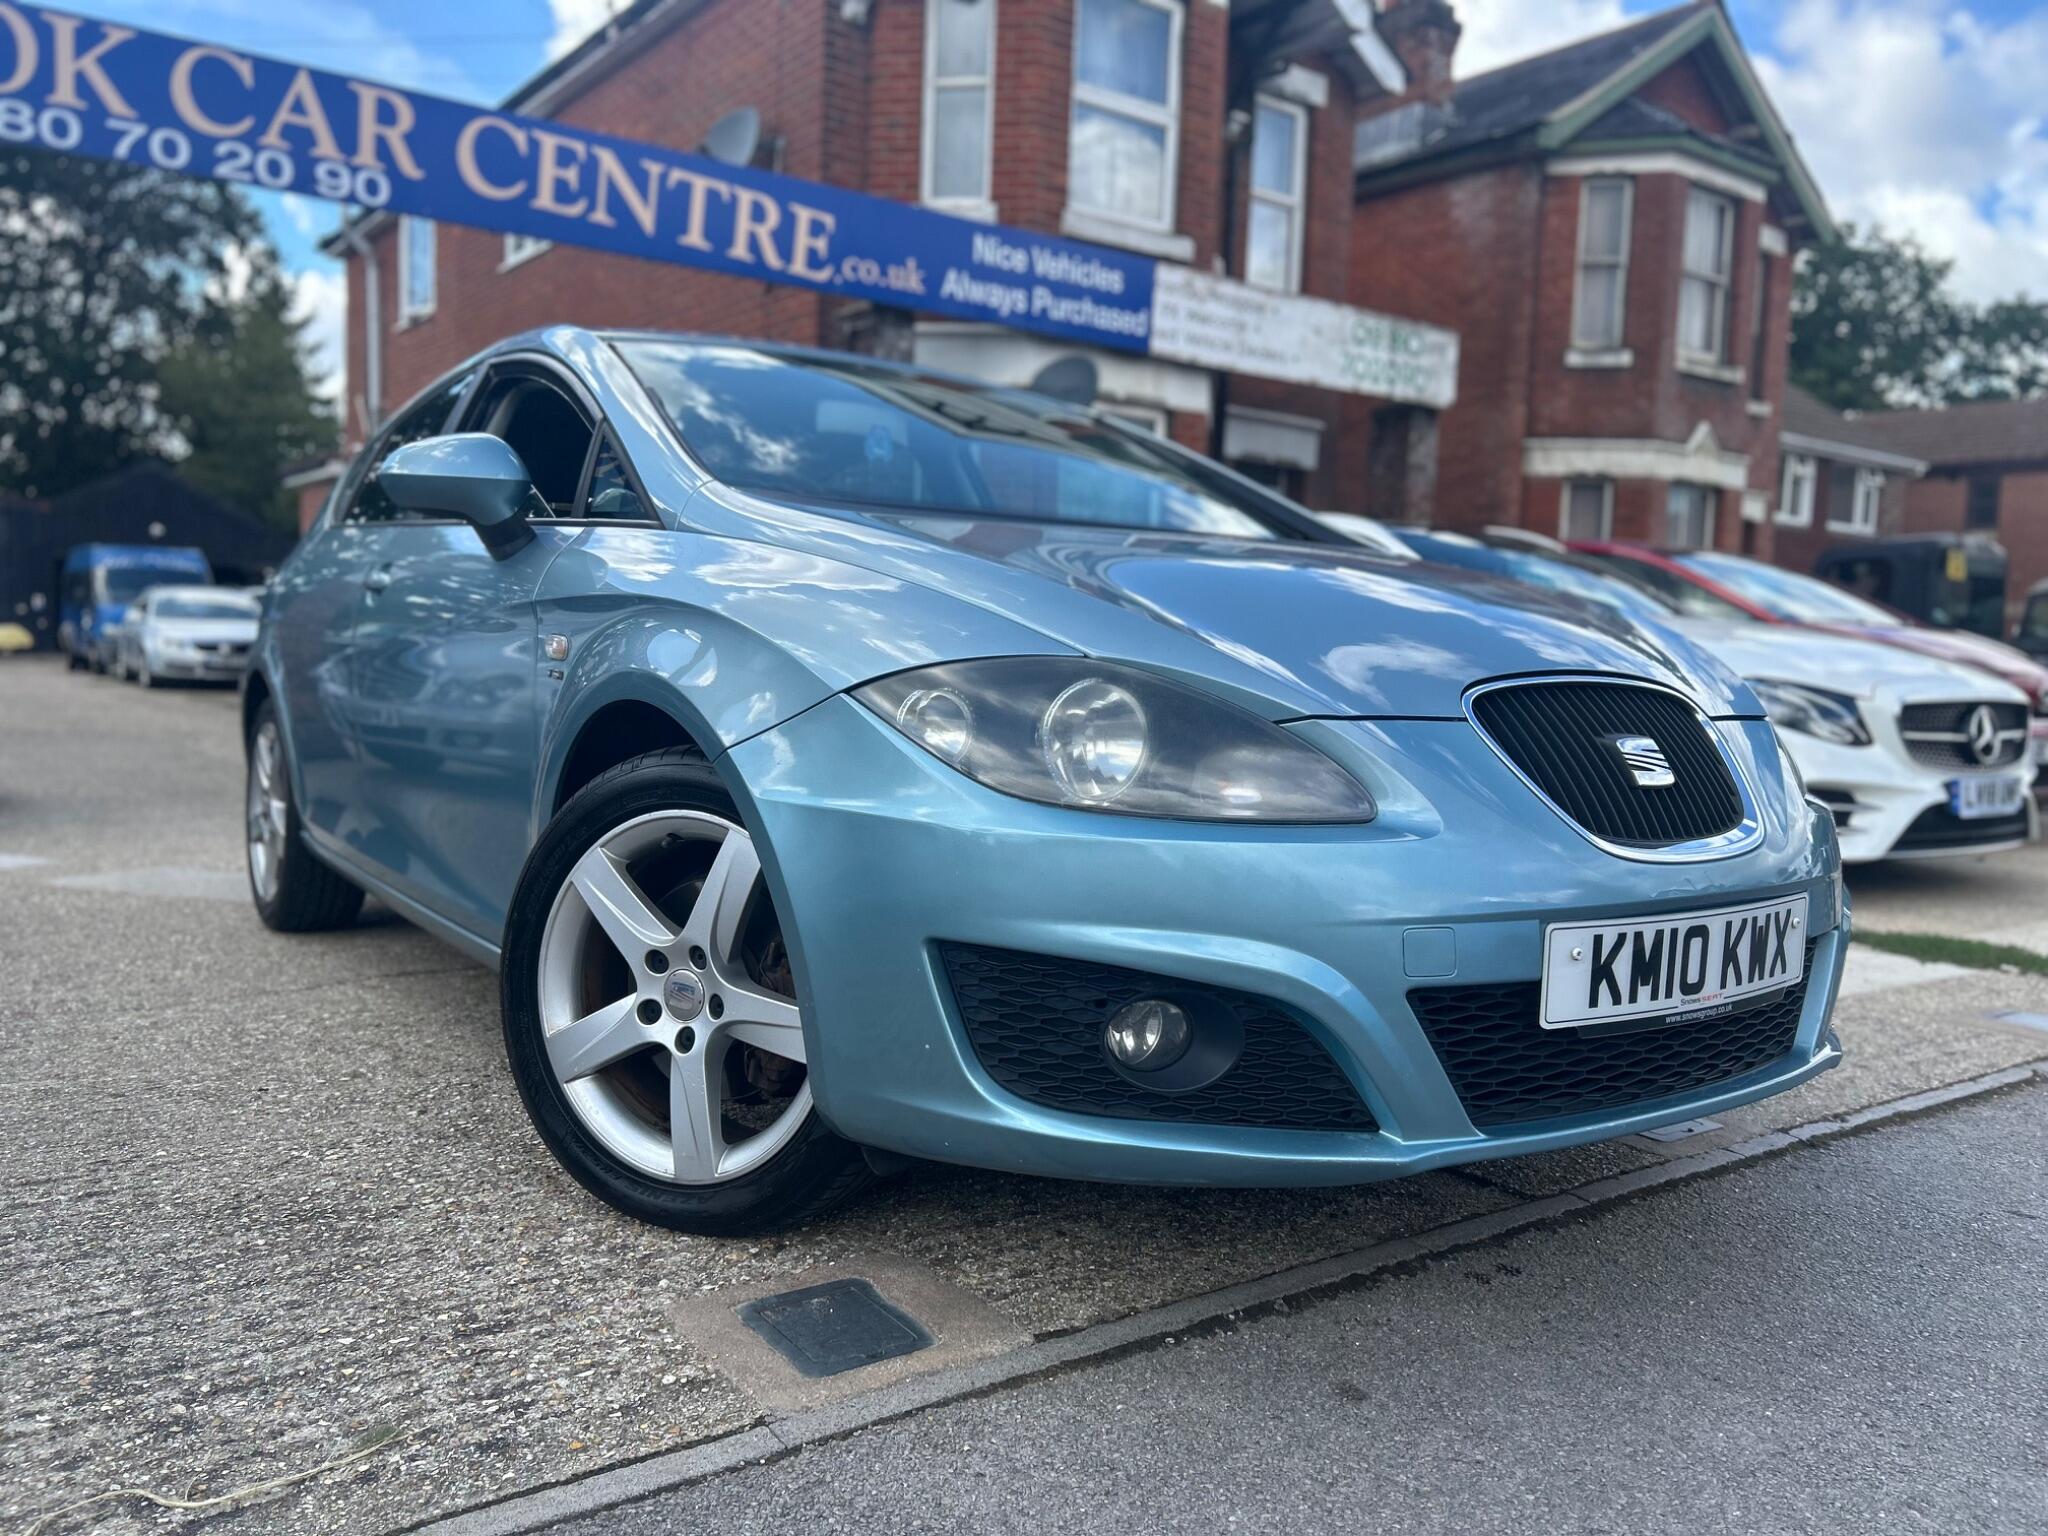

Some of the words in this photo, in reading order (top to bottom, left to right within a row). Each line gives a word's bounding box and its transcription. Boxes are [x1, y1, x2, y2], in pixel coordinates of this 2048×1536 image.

[169, 46, 425, 182] CAR
[105, 118, 192, 170] 70
[213, 140, 295, 189] 20
[314, 160, 391, 208] 90
[940, 267, 1028, 318] Always
[1030, 284, 1149, 338] Purchased
[971, 231, 1029, 275] Nice
[1029, 245, 1125, 295] Vehicles
[1588, 923, 1710, 1009] KM10
[1719, 908, 1792, 990] KWX
